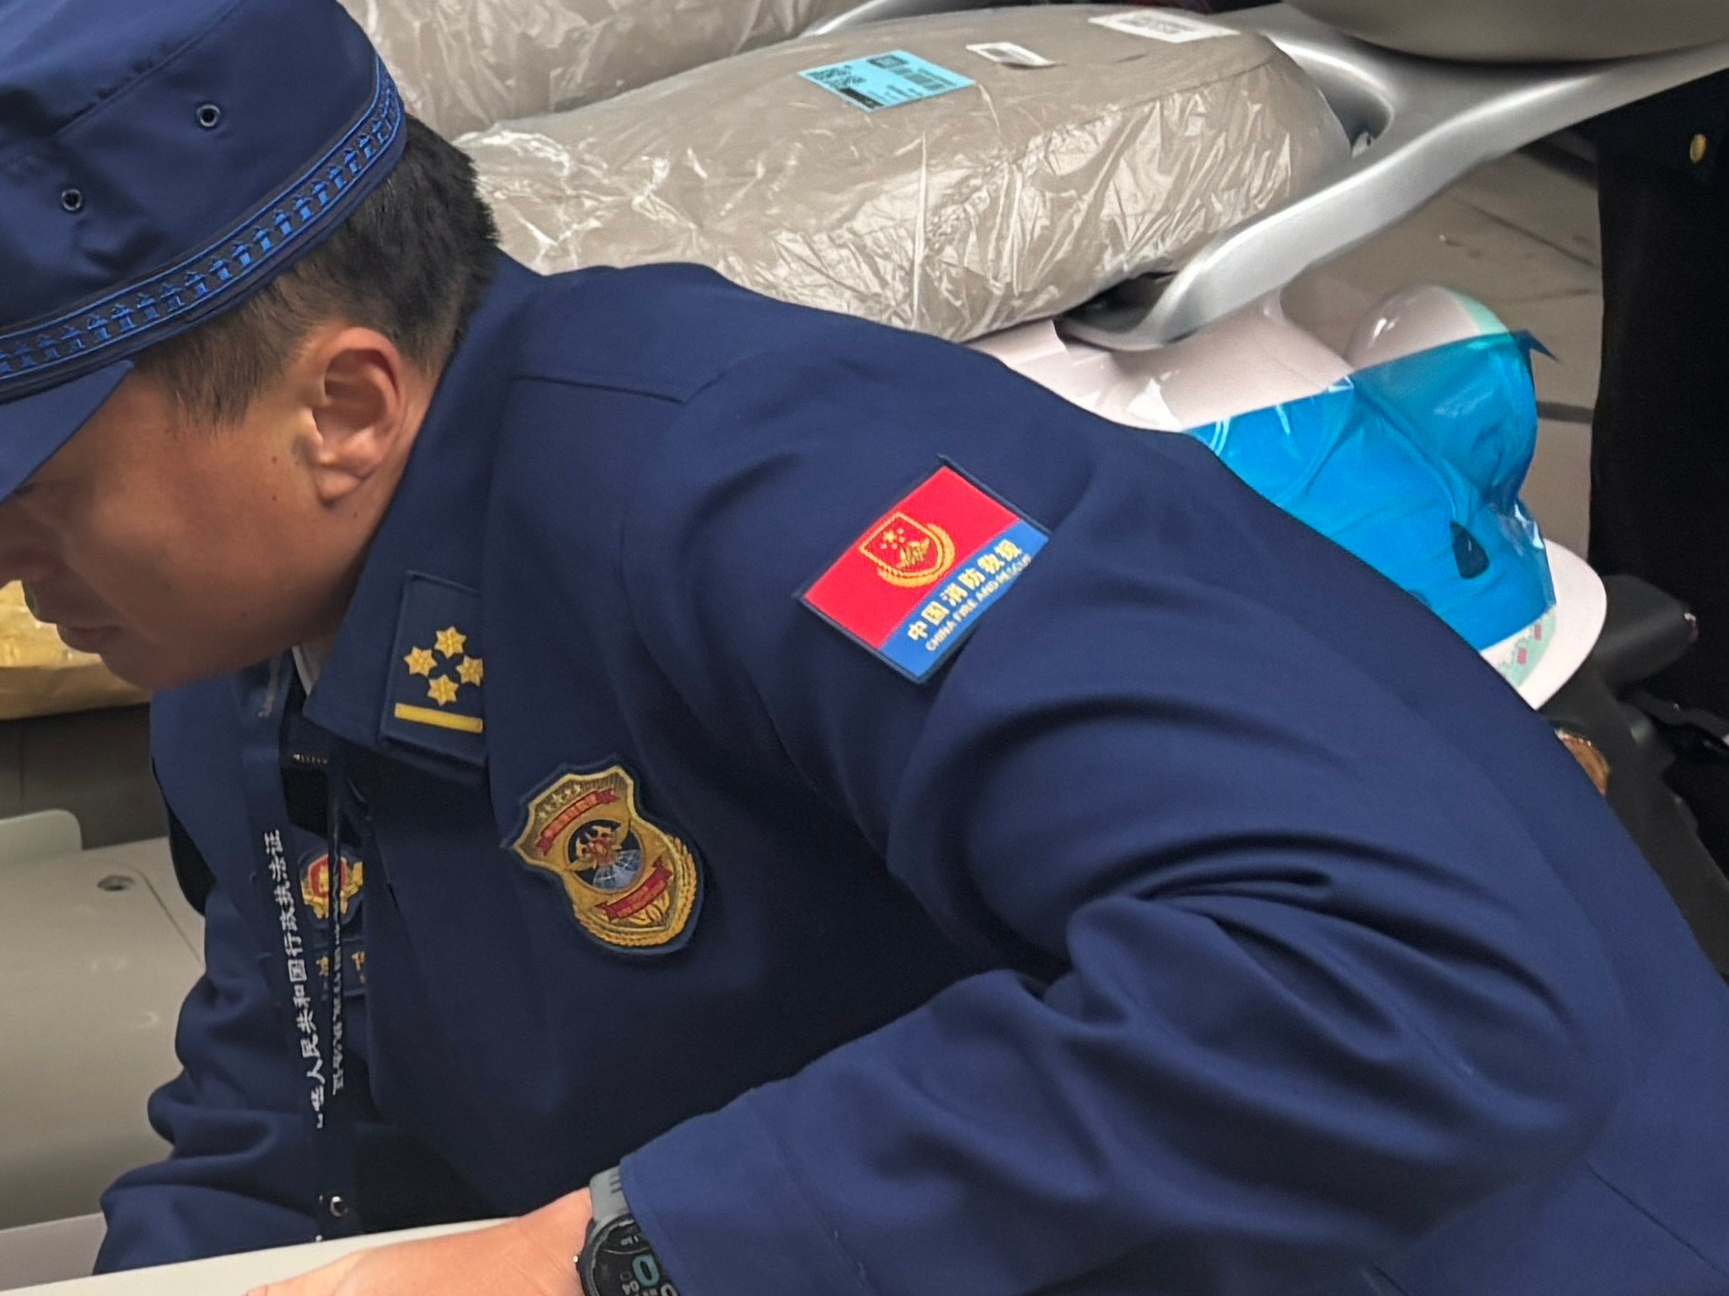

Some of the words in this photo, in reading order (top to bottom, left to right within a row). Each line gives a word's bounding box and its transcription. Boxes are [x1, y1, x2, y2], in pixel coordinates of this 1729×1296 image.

[906, 536, 1024, 644] 中国消防救援
[264, 829, 327, 1130] 华人民共和国行政执法证
